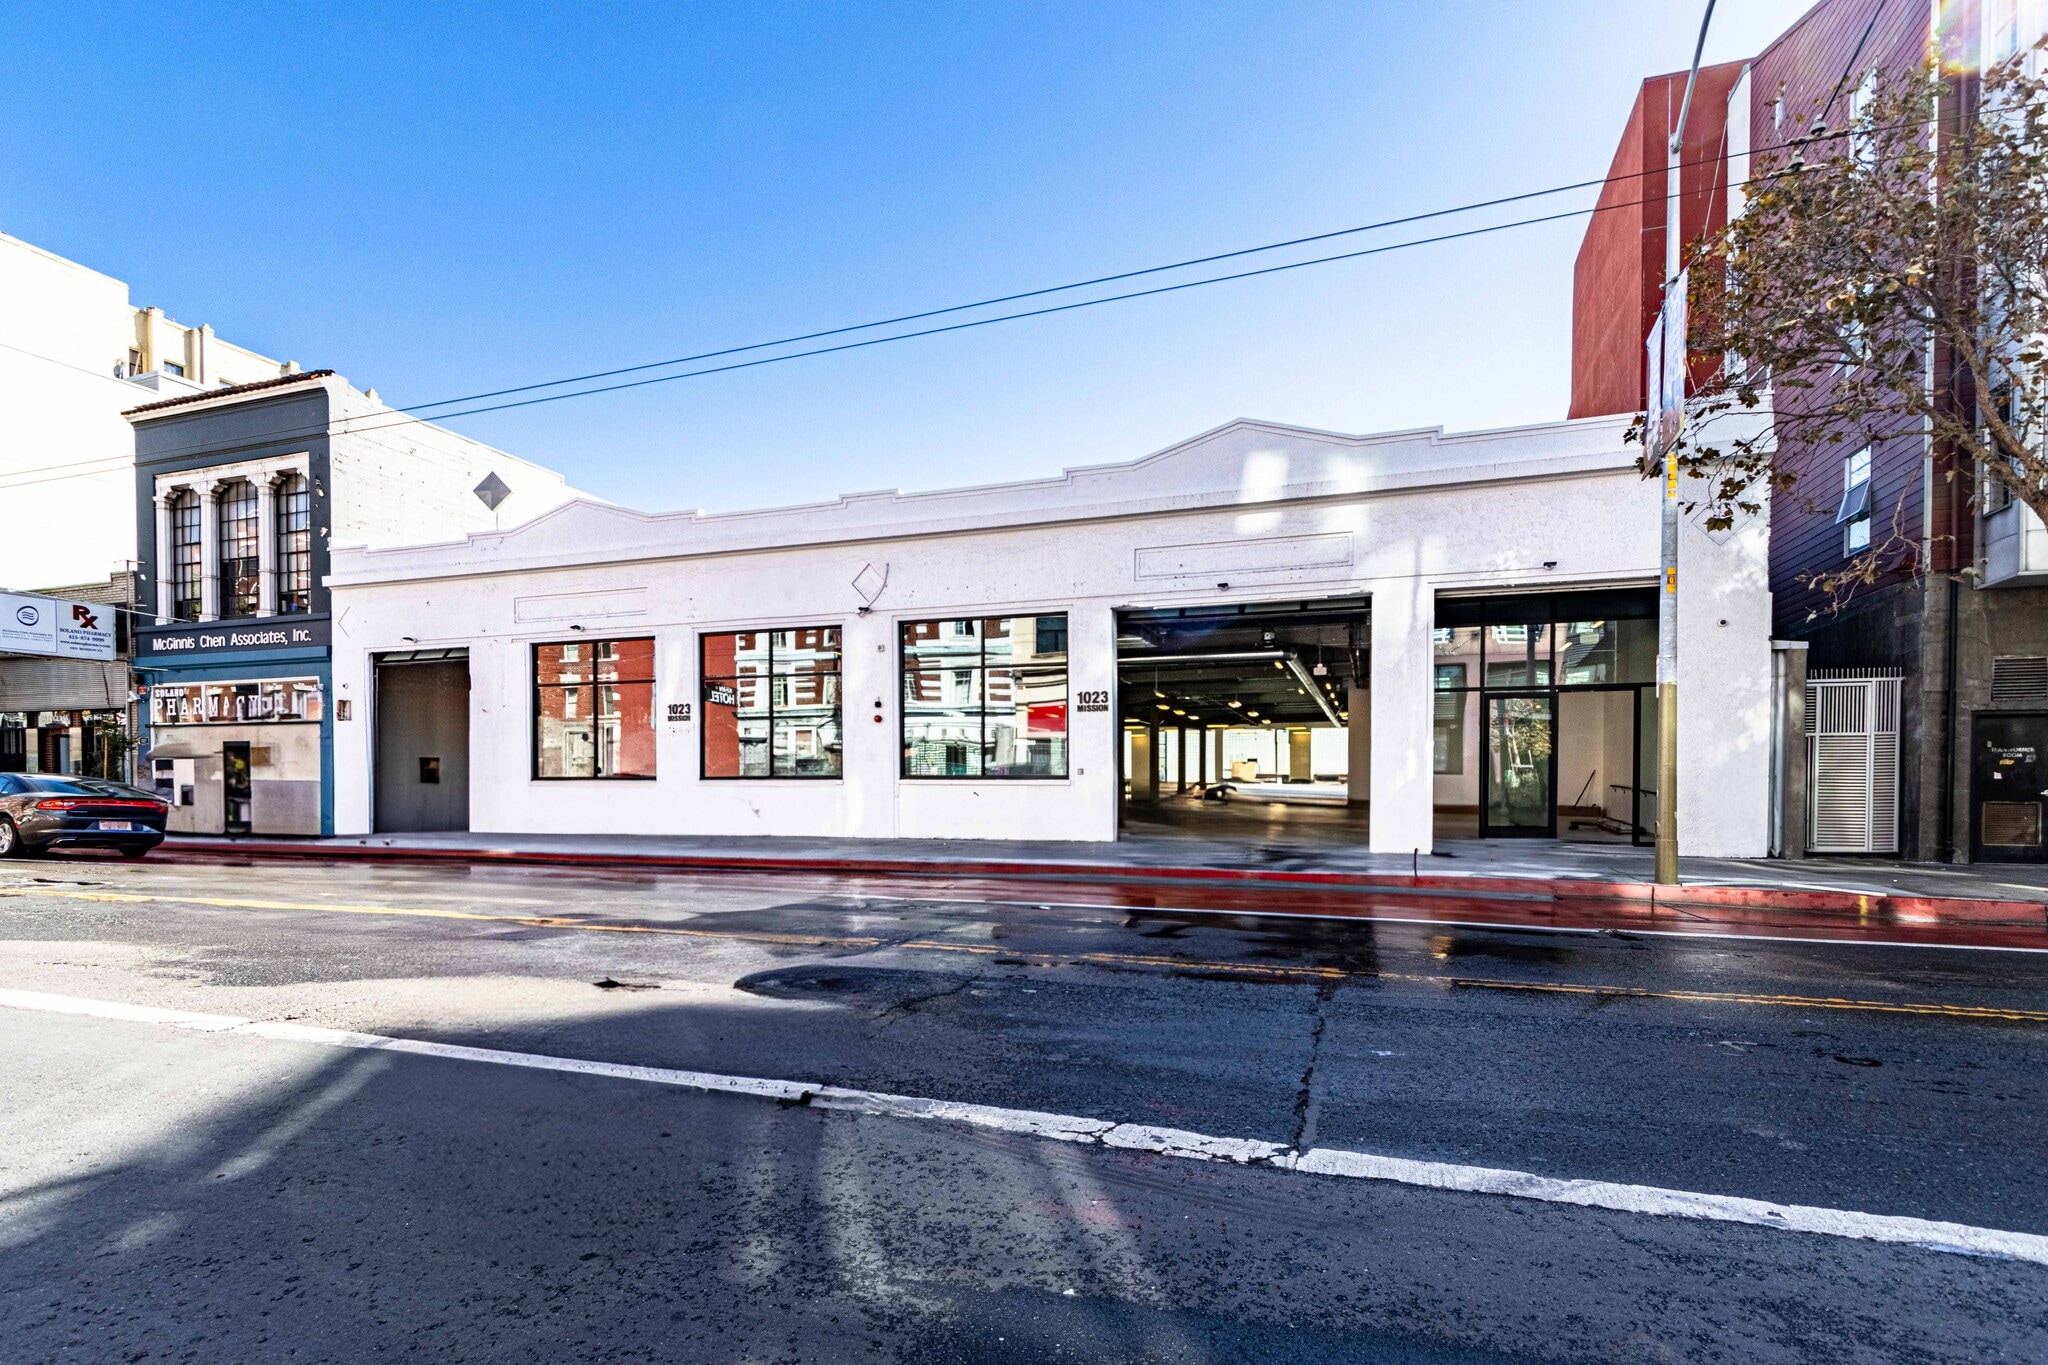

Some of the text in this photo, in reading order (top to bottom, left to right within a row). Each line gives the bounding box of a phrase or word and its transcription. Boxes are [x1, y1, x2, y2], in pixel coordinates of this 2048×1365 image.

[82, 630, 112, 638] PHARMACY
[152, 628, 312, 651] McGinnis Chen Associates, Inc.
[1077, 691, 1109, 704] 1023
[668, 703, 691, 715] 1023
[1077, 704, 1109, 712] MISSION
